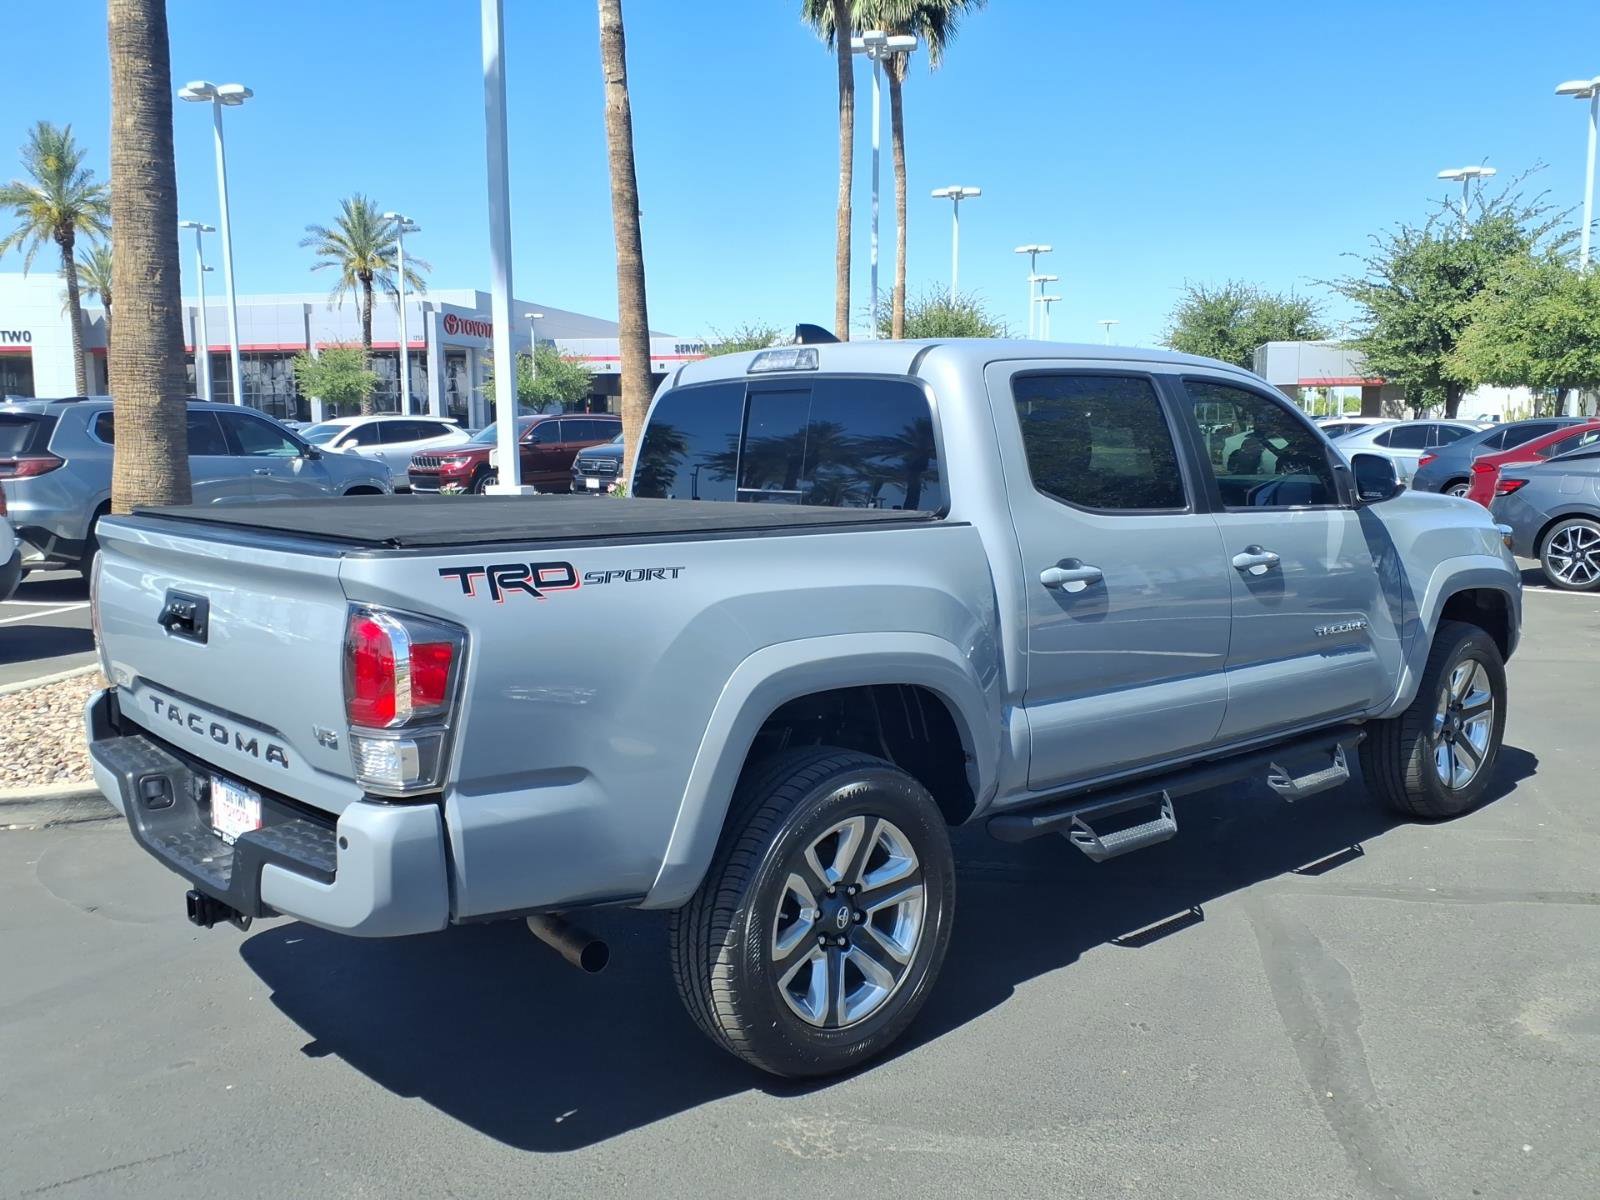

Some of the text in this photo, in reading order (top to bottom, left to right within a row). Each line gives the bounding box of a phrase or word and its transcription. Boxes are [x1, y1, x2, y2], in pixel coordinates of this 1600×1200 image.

[0, 330, 32, 343] TWO
[459, 318, 494, 338] TOYOT
[438, 561, 686, 603] TRD SPORT
[149, 695, 289, 769] TACOMA
